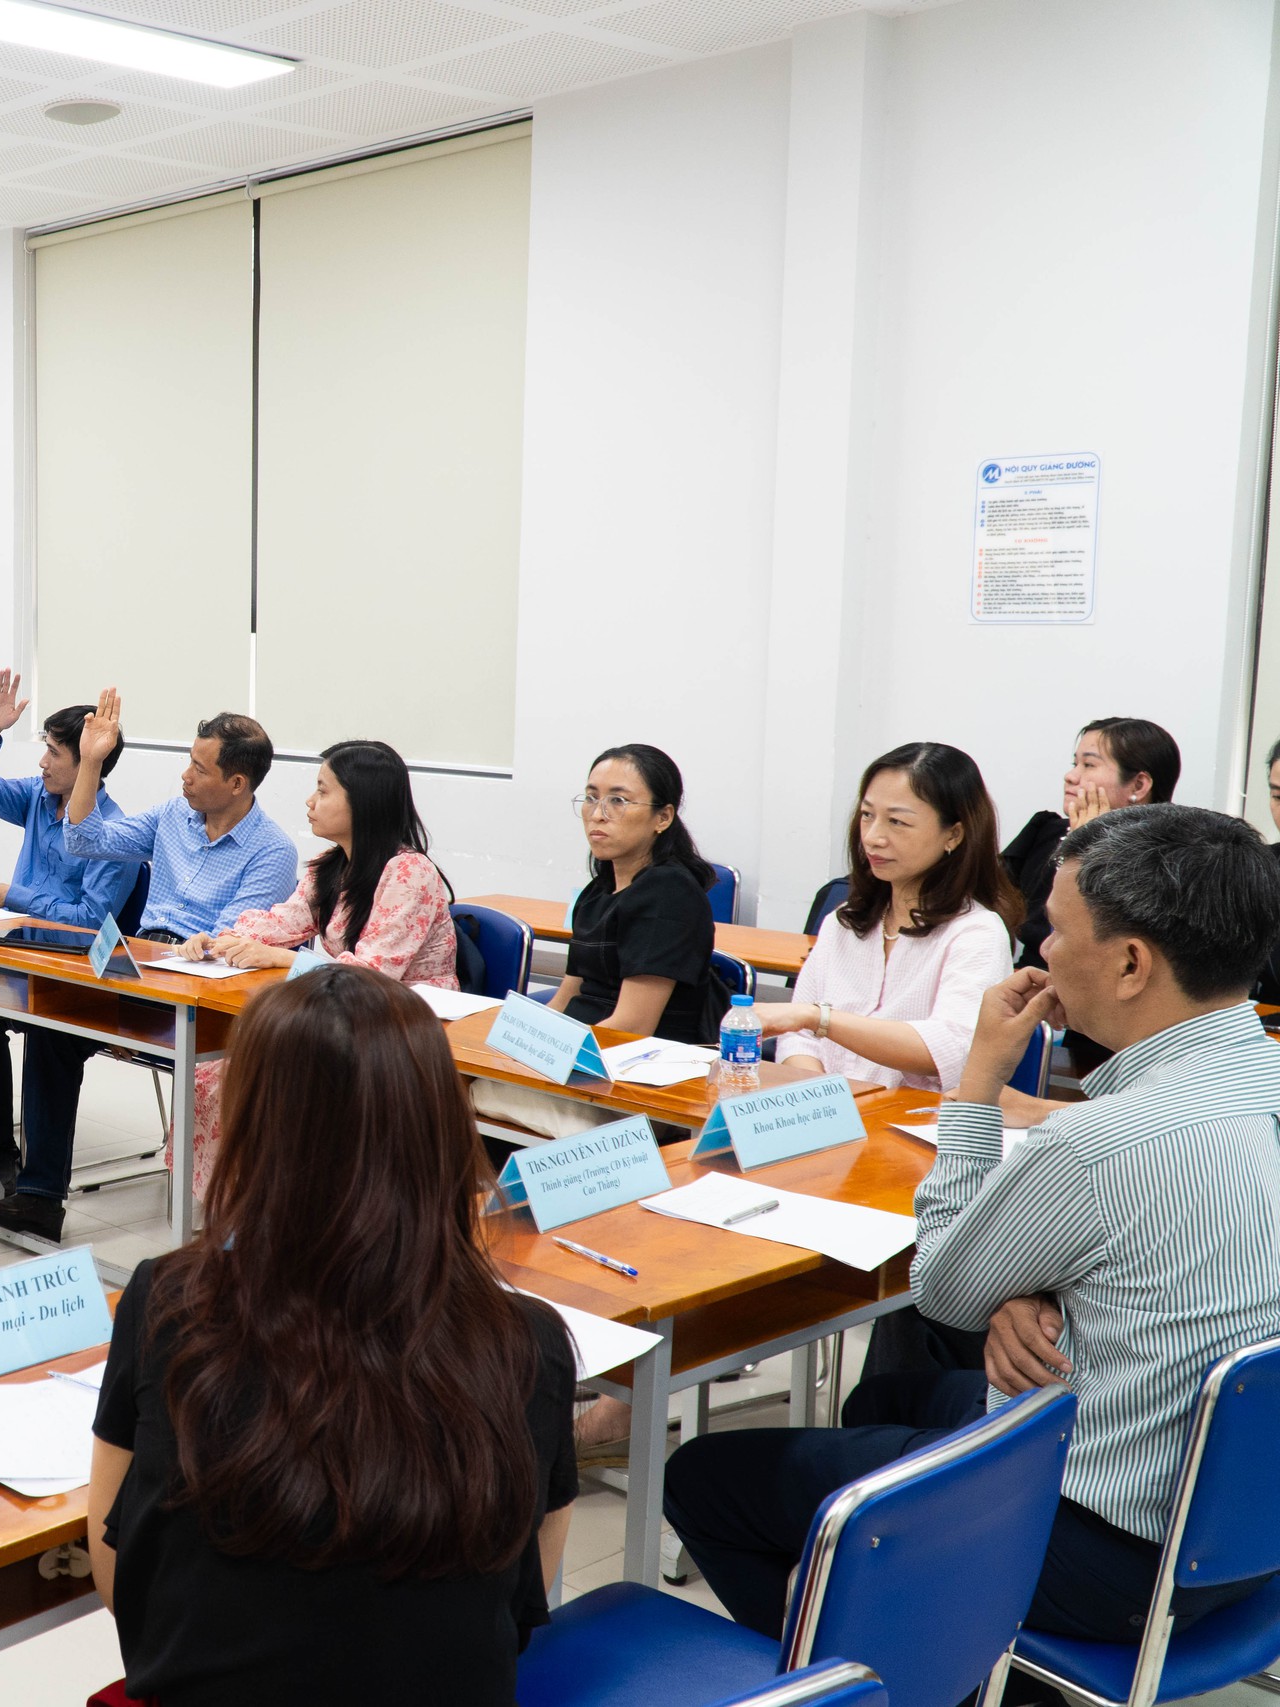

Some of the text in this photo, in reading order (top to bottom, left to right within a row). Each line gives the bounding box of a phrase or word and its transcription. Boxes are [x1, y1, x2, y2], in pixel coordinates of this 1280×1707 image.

[730, 1080, 846, 1118] TS.DƯƠNG QUANG HÒA
[752, 1105, 837, 1134] Khoa Khoa học dữ liệu
[526, 1128, 649, 1175] ThS.NGUYỄN VŨ DZŨNG
[631, 1152, 649, 1165] thuật
[582, 1185, 597, 1196] Cao
[30, 1265, 81, 1293] TRÚC
[2, 1311, 26, 1333] mại
[39, 1305, 58, 1321] Du
[61, 1295, 86, 1317] lịch
